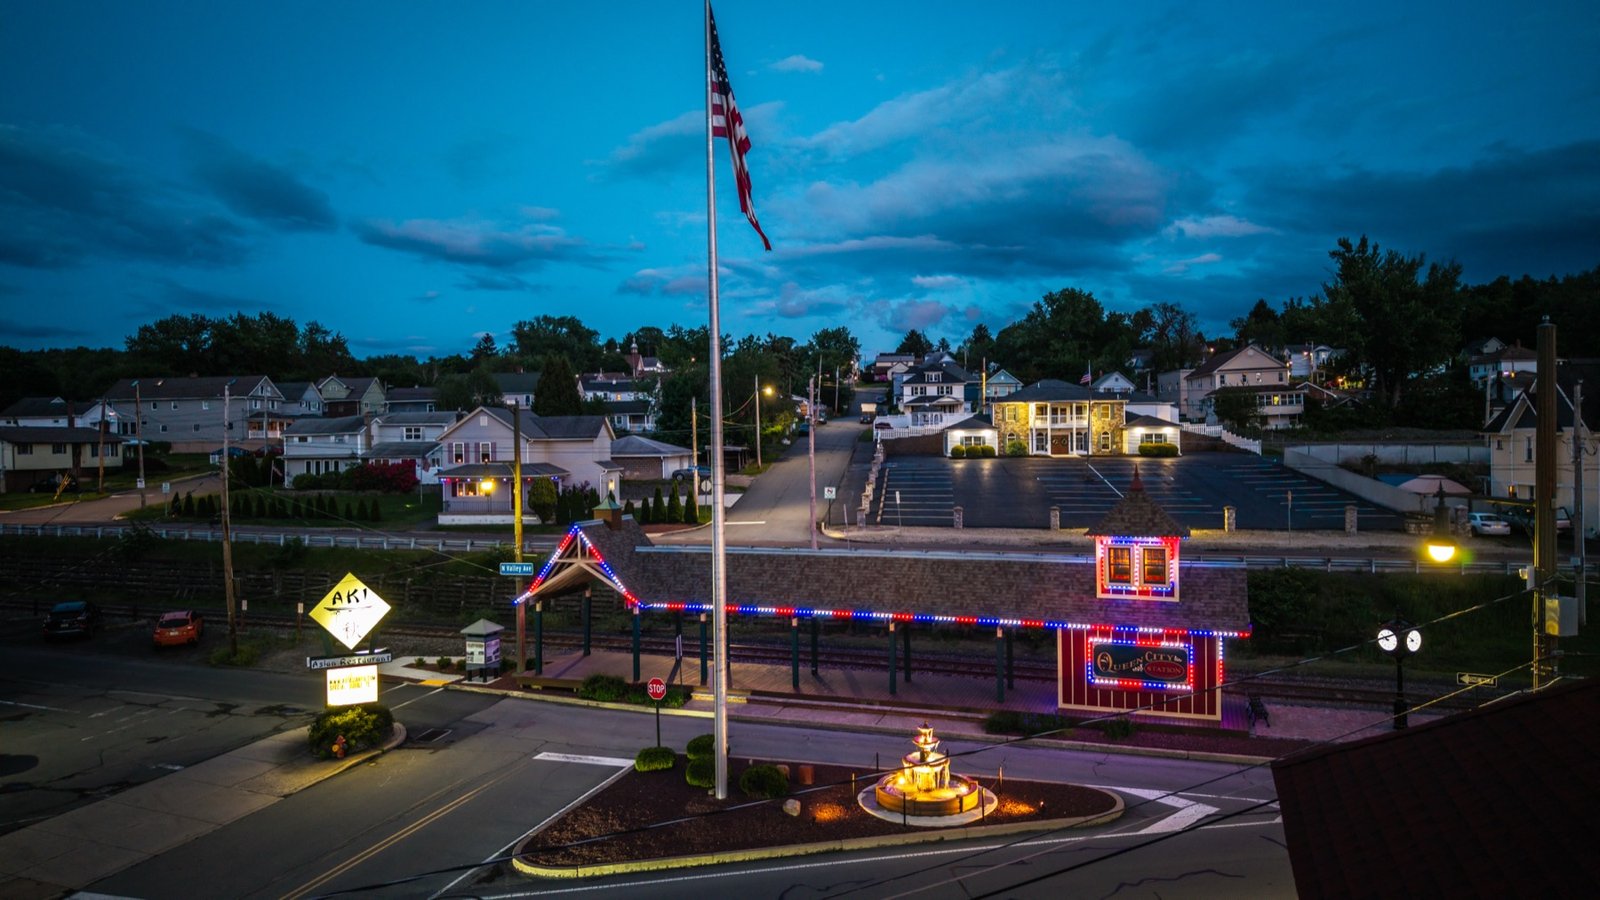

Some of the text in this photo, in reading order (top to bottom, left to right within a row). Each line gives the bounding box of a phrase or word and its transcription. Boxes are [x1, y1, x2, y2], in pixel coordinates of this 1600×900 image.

[312, 654, 391, 668] Asian Restaurant
[1146, 666, 1182, 674] STATION
[648, 684, 665, 693] STOP
